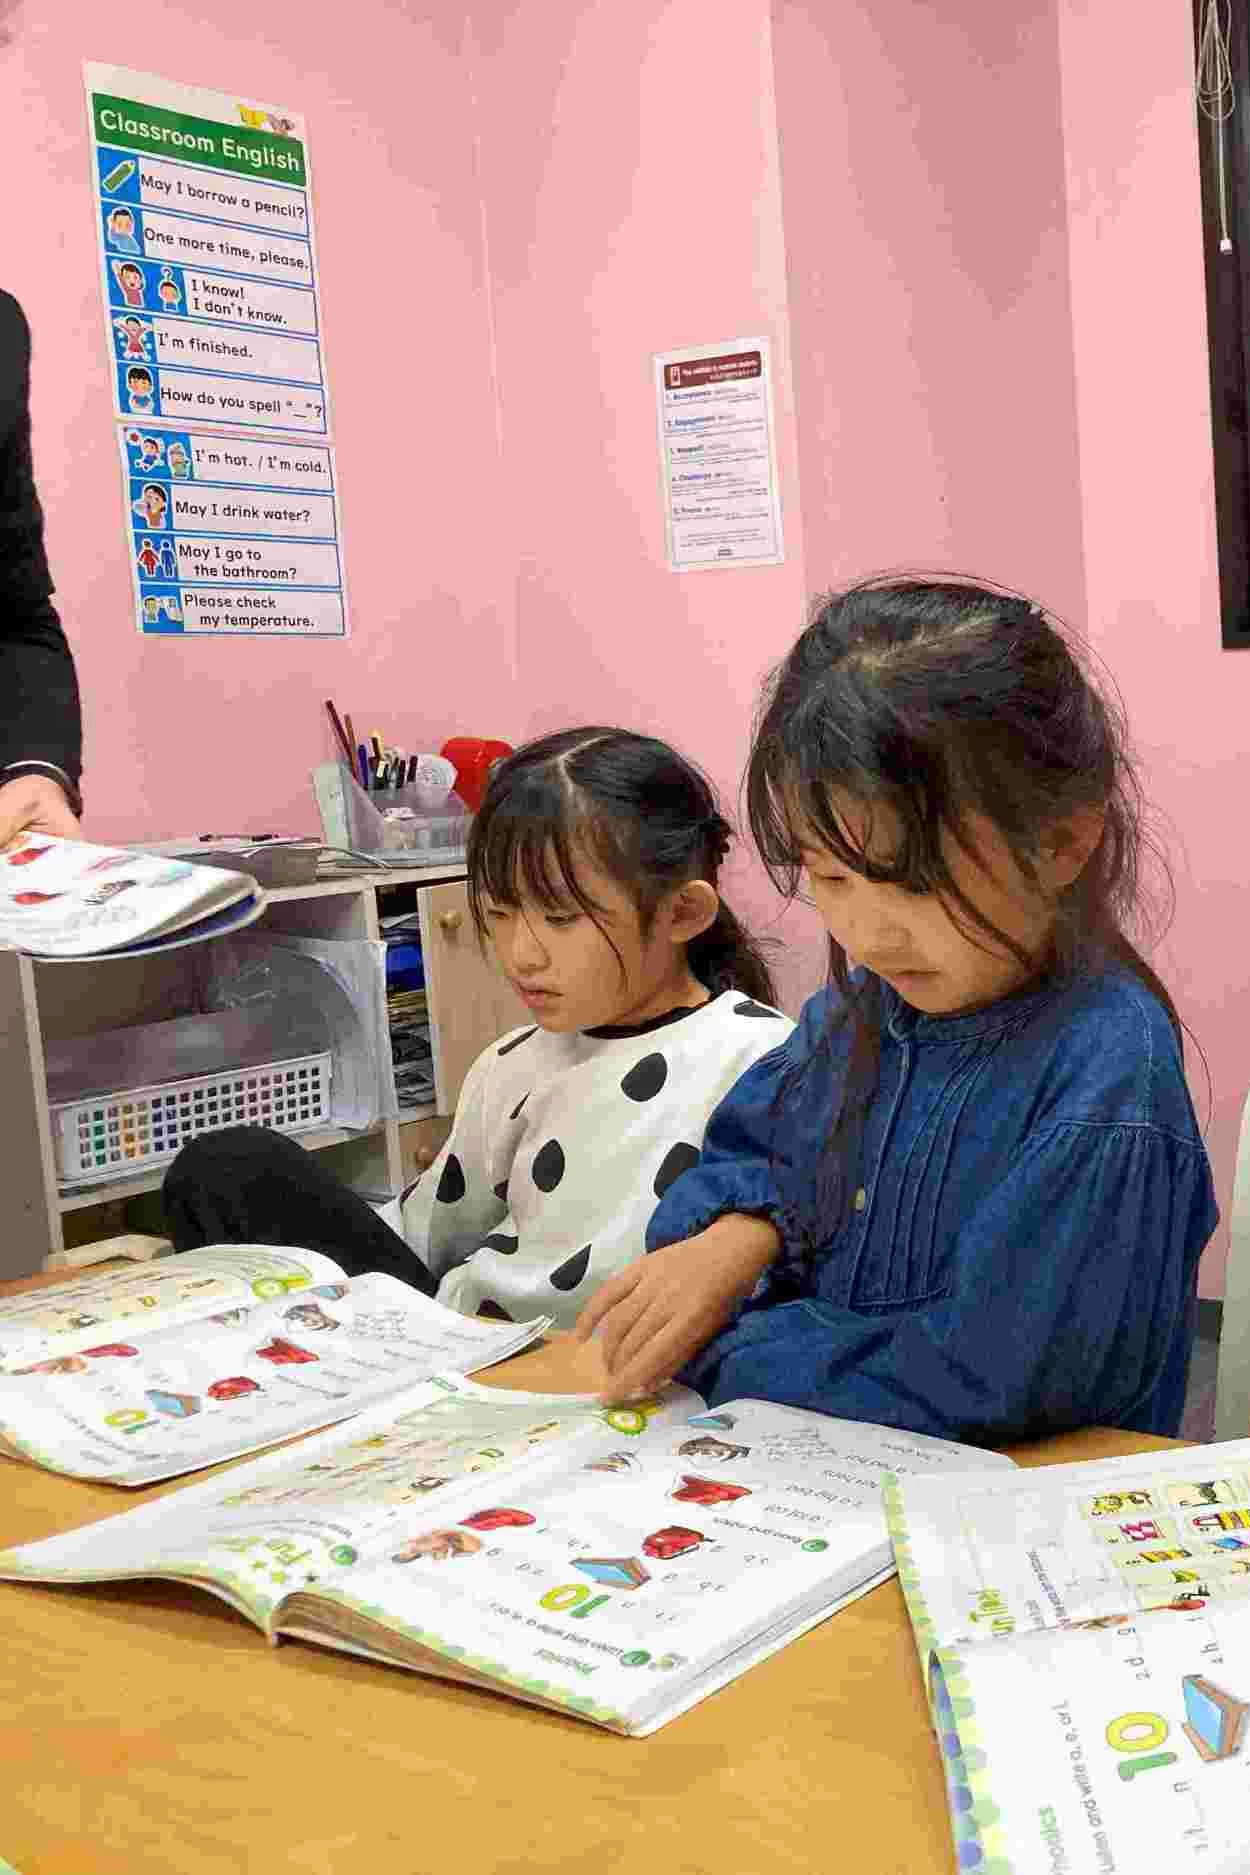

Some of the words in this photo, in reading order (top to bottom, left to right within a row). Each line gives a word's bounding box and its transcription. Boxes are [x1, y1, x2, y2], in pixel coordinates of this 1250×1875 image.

[100, 109, 214, 153] Classroom
[222, 138, 300, 172] English
[141, 174, 171, 194] May
[187, 184, 237, 206] borrow
[242, 198, 250, 208] a
[255, 200, 304, 219] pencil?
[144, 227, 173, 245] One
[179, 235, 214, 252] more
[220, 242, 255, 261] time,
[259, 250, 308, 270] please.
[192, 279, 198, 292] I
[203, 281, 245, 299] know!
[193, 298, 200, 310] I
[206, 298, 243, 316] don't
[247, 304, 287, 325] know.
[158, 333, 184, 349] I'm
[190, 338, 253, 358] finished.
[161, 388, 193, 401] How
[197, 392, 215, 405] do
[220, 395, 244, 411] you
[249, 399, 281, 414] spell
[195, 449, 220, 464] I'm
[225, 452, 253, 467] hot.
[267, 455, 291, 470] I'm
[295, 459, 327, 473] cold.
[175, 501, 207, 518] May
[212, 503, 218, 515] I
[222, 504, 259, 520] drink
[264, 508, 311, 522] water?
[179, 545, 210, 561] May
[226, 549, 243, 561] go
[247, 548, 261, 560] to
[194, 565, 218, 577] the
[222, 565, 297, 580] bathroom?
[184, 594, 232, 609] Please
[236, 595, 277, 609] check
[200, 614, 220, 628] my
[224, 614, 315, 629] temperature.
[1080, 1799, 1102, 1827] and
